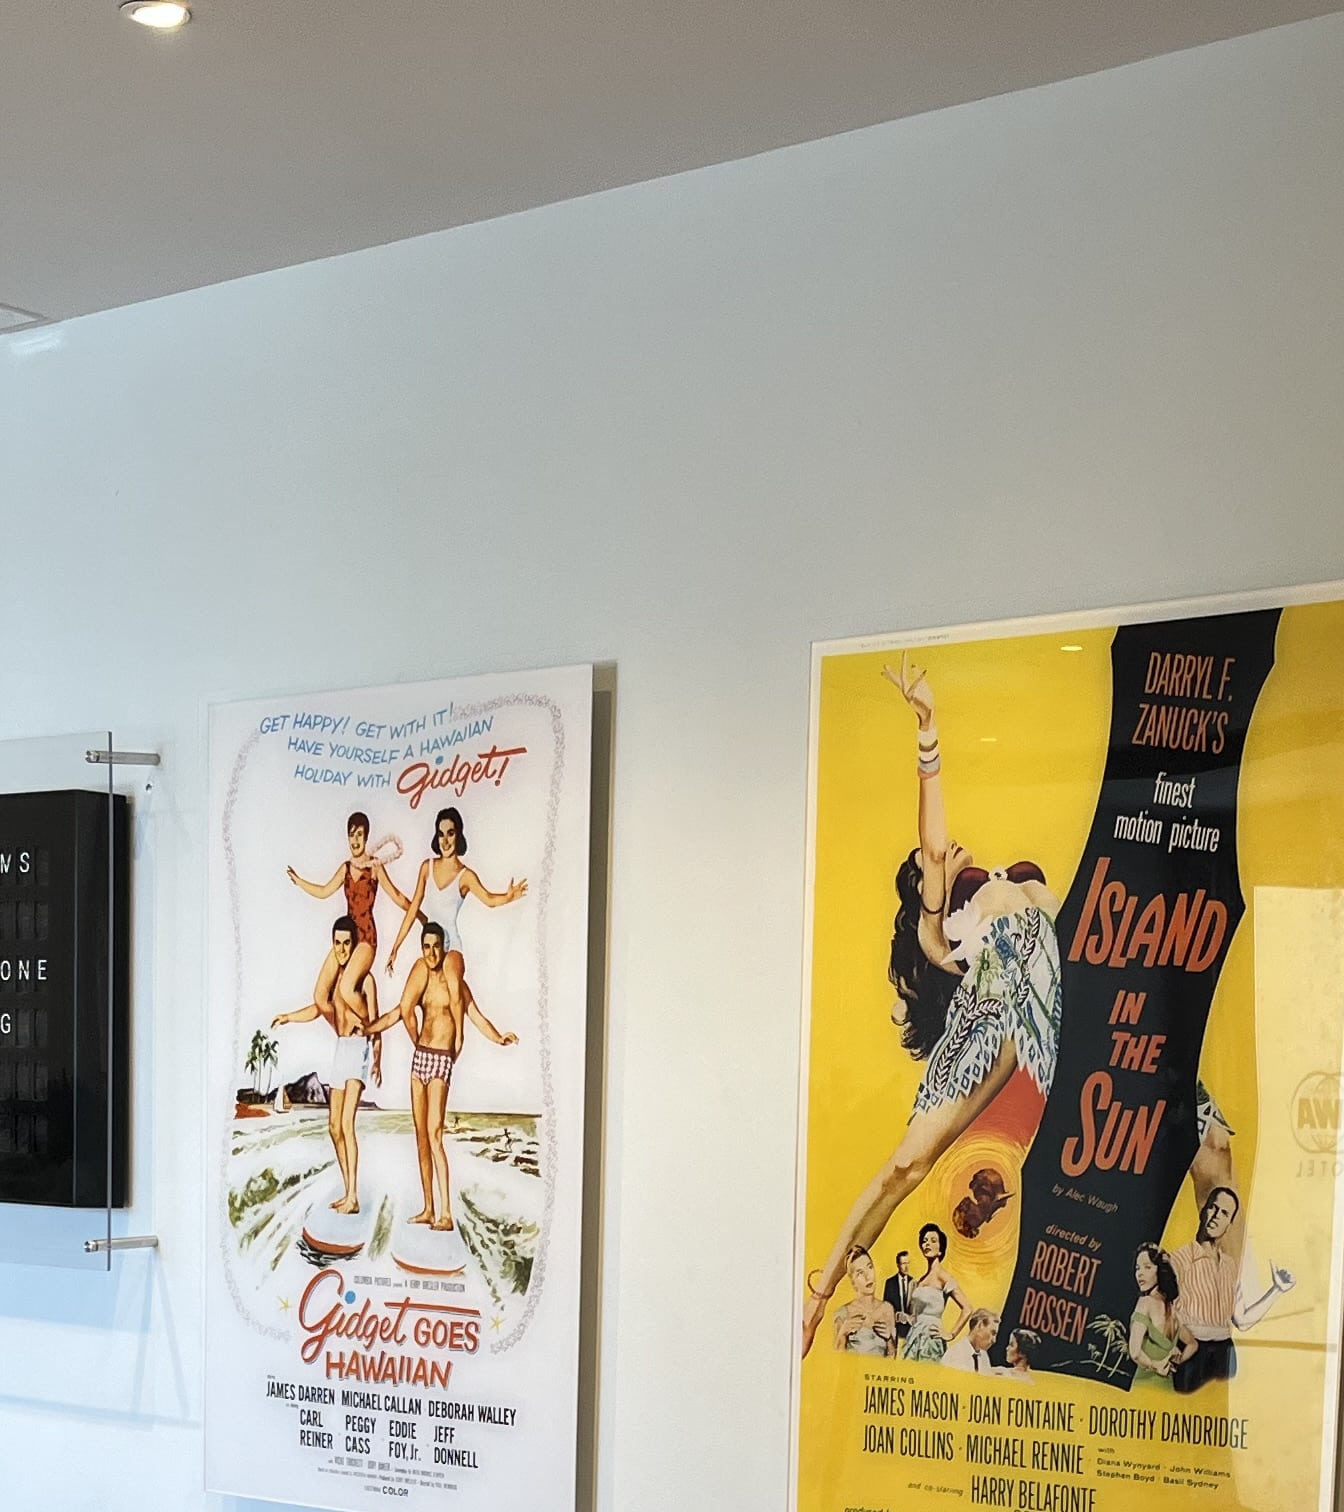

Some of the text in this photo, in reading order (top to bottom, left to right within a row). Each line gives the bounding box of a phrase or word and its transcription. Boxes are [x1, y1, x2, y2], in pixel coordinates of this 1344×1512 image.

[1144, 652, 1233, 701] DARRYL F.
[259, 702, 455, 741] GET HAPPY! GET WITH IT!
[287, 716, 494, 765] HAVE YOURSELF A HAWAIIAN
[1132, 703, 1229, 754] ZANUCK'S
[294, 745, 527, 809] HOLIDAY WITH Gidget!
[1153, 771, 1196, 808] finest
[1114, 810, 1220, 853] motion picture
[1068, 856, 1228, 972] ISLAND
[0, 959, 47, 981] ONE
[1108, 990, 1147, 1025] IN
[1109, 1031, 1167, 1074] THE
[1061, 1071, 1167, 1177] SUN
[1065, 1186, 1120, 1214] Alec Waugh
[1045, 1224, 1087, 1247] directed
[1030, 1240, 1102, 1297] ROBERT
[298, 1268, 481, 1365] Gidget GOES
[1019, 1286, 1089, 1345] ROSSEN
[325, 1350, 453, 1390] HAWAIIAN
[864, 1374, 915, 1385] STARRING
[266, 1381, 516, 1427] JAMES DARREN MICHAEL CALLAN DEBORAH WALLEY
[863, 1385, 1249, 1450] JAMES MASON JOAN FONTAINE DOROTHY DANDRIDGE
[299, 1409, 456, 1444] CARL PEGGY EDDIE JEFF
[299, 1430, 333, 1450] REINER
[345, 1435, 371, 1455] CASS
[434, 1447, 479, 1469] DONNELL
[862, 1424, 1085, 1475] JOAN COLLINS MICHAEL RENNIE
[382, 1486, 409, 1497] COLOR
[971, 1475, 1014, 1507] HARRY
